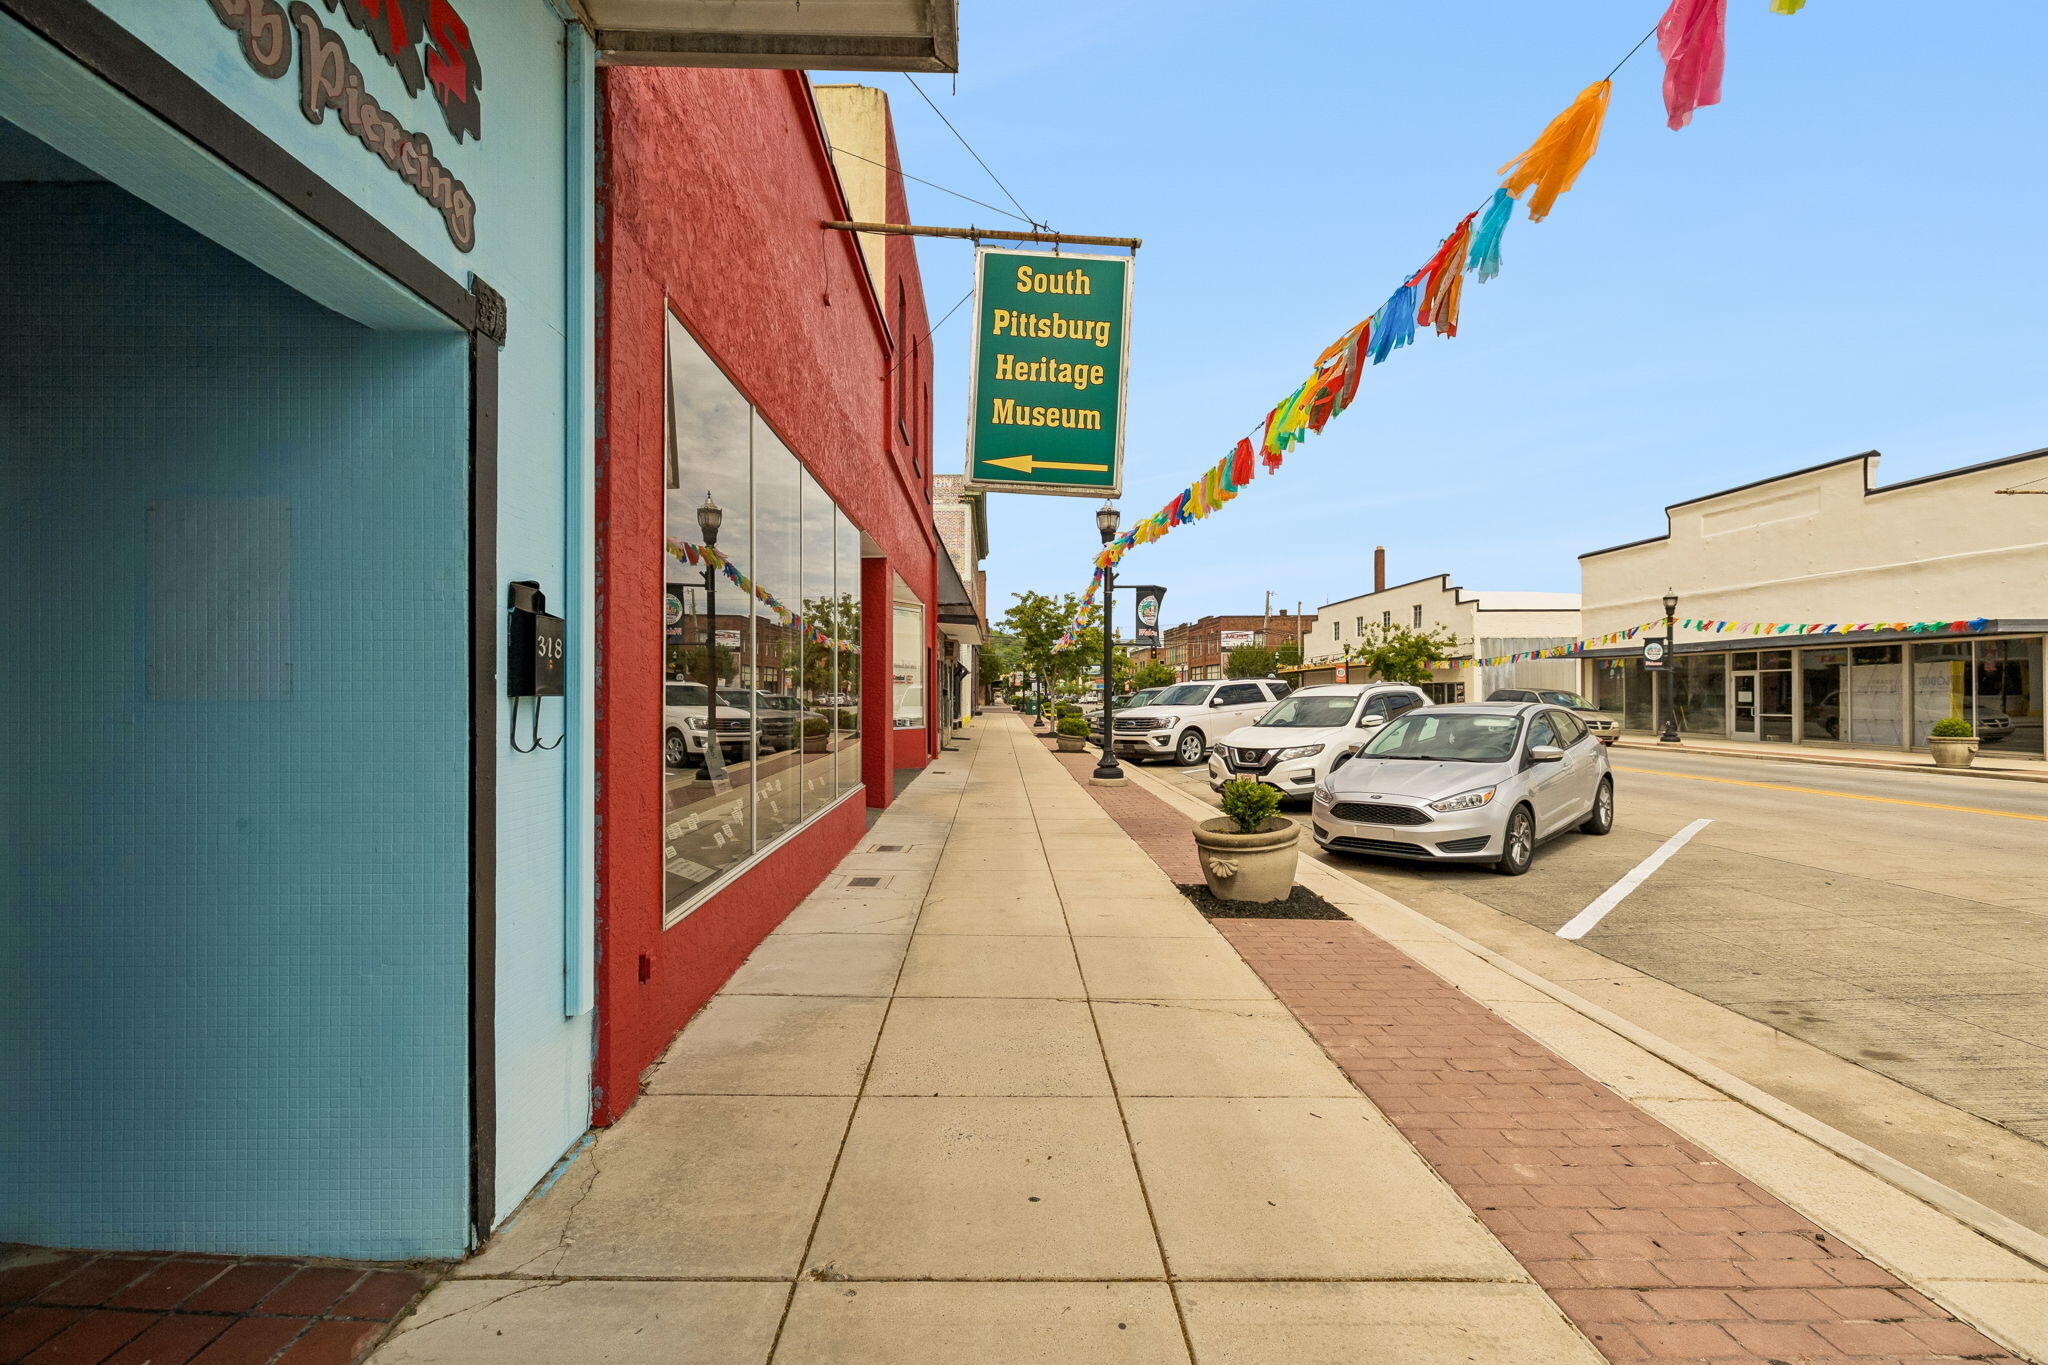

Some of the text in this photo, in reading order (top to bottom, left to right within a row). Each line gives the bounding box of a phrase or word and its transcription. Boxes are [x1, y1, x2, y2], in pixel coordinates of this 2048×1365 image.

[1016, 264, 1091, 296] South
[992, 308, 1111, 348] Pittsburg
[995, 353, 1105, 391] Heritage
[991, 398, 1102, 431] Museum
[537, 635, 563, 660] 318
